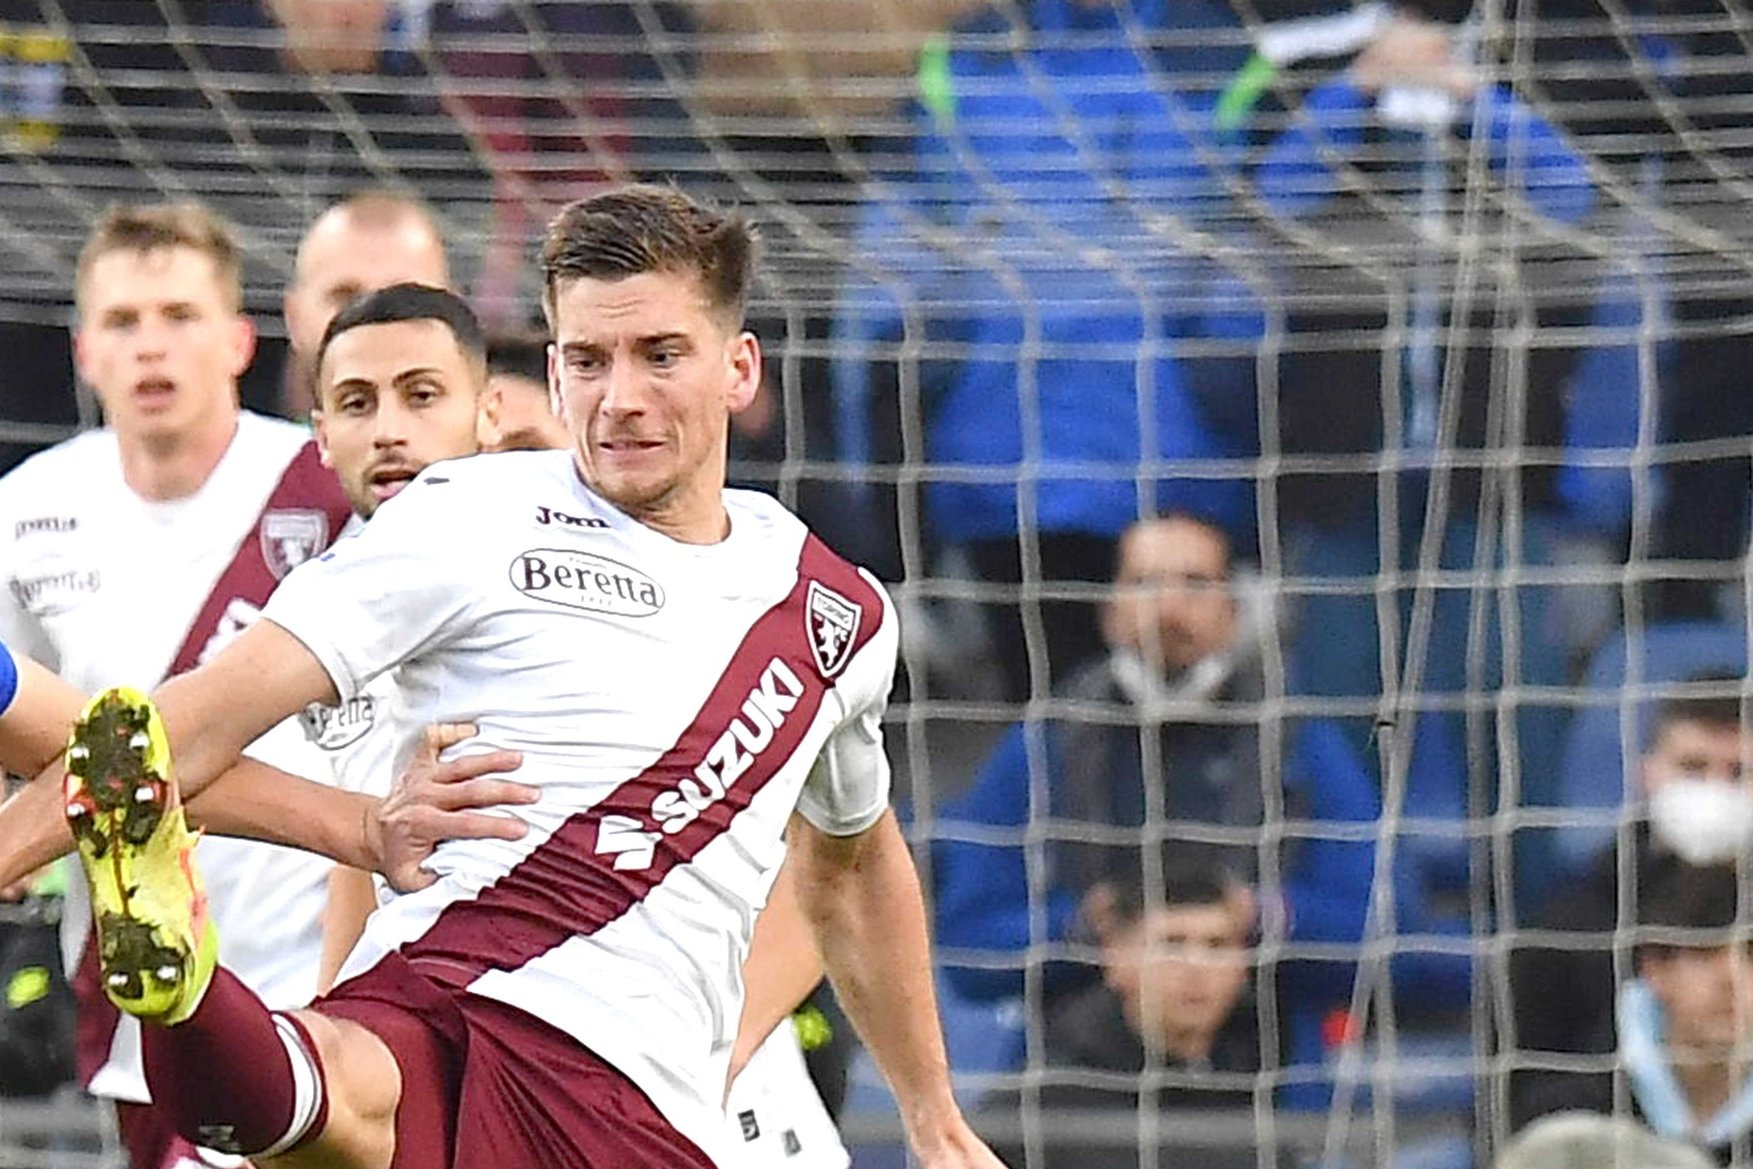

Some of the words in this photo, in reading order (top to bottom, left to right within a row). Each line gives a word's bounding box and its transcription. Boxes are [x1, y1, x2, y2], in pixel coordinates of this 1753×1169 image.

[535, 505, 612, 529] Jom
[522, 556, 662, 608] Beretta
[650, 656, 805, 835] SUZUKI
